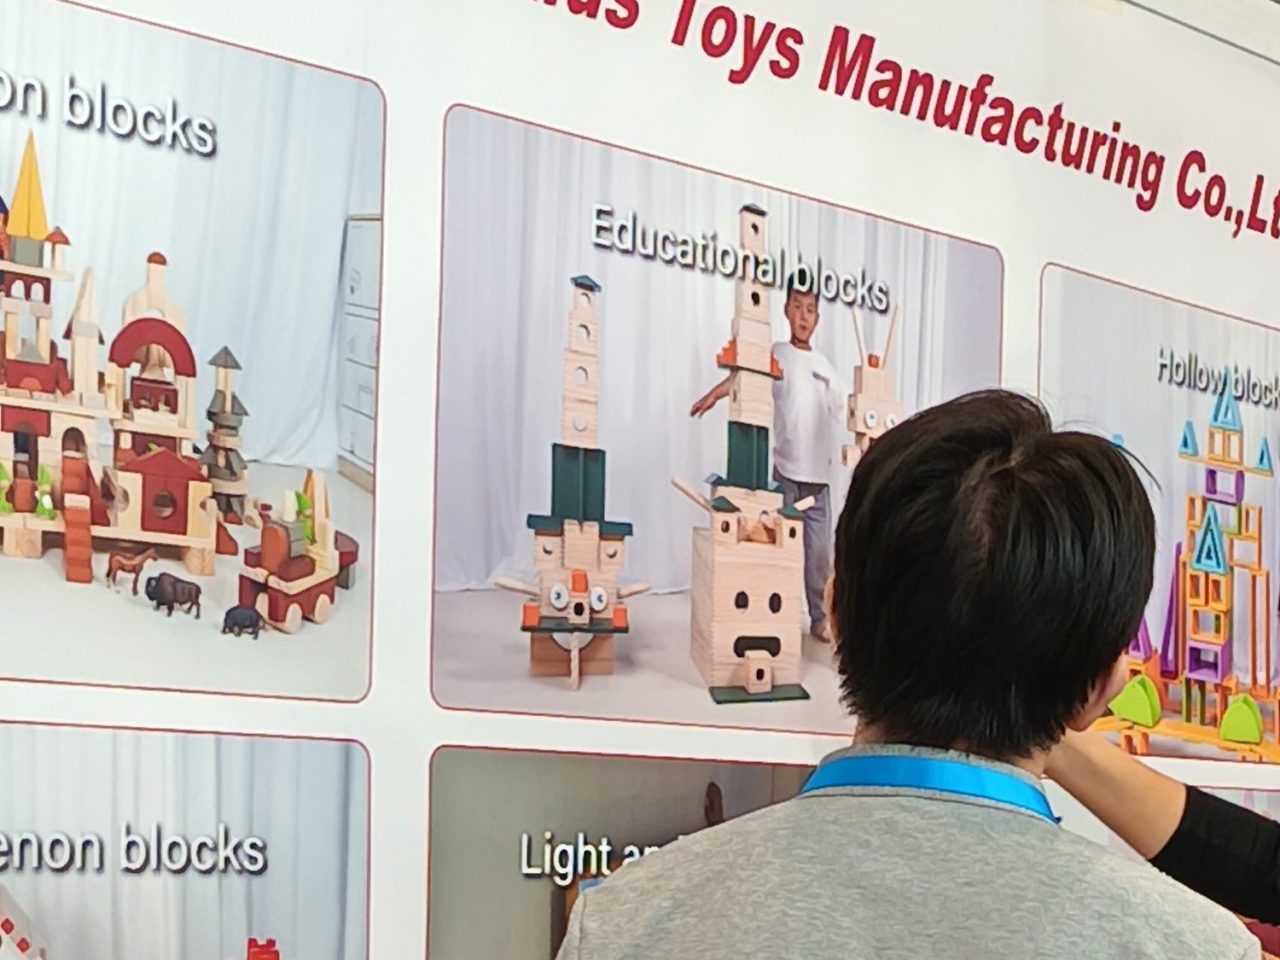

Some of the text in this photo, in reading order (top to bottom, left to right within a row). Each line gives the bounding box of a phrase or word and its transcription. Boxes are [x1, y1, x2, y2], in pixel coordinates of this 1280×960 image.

[64, 73, 217, 158] blocks
[818, 25, 1165, 212] Manufacturing
[591, 204, 891, 314] Educational blocks
[1158, 346, 1228, 397] Hollow
[121, 821, 268, 875] blocks
[521, 831, 612, 887] Light
